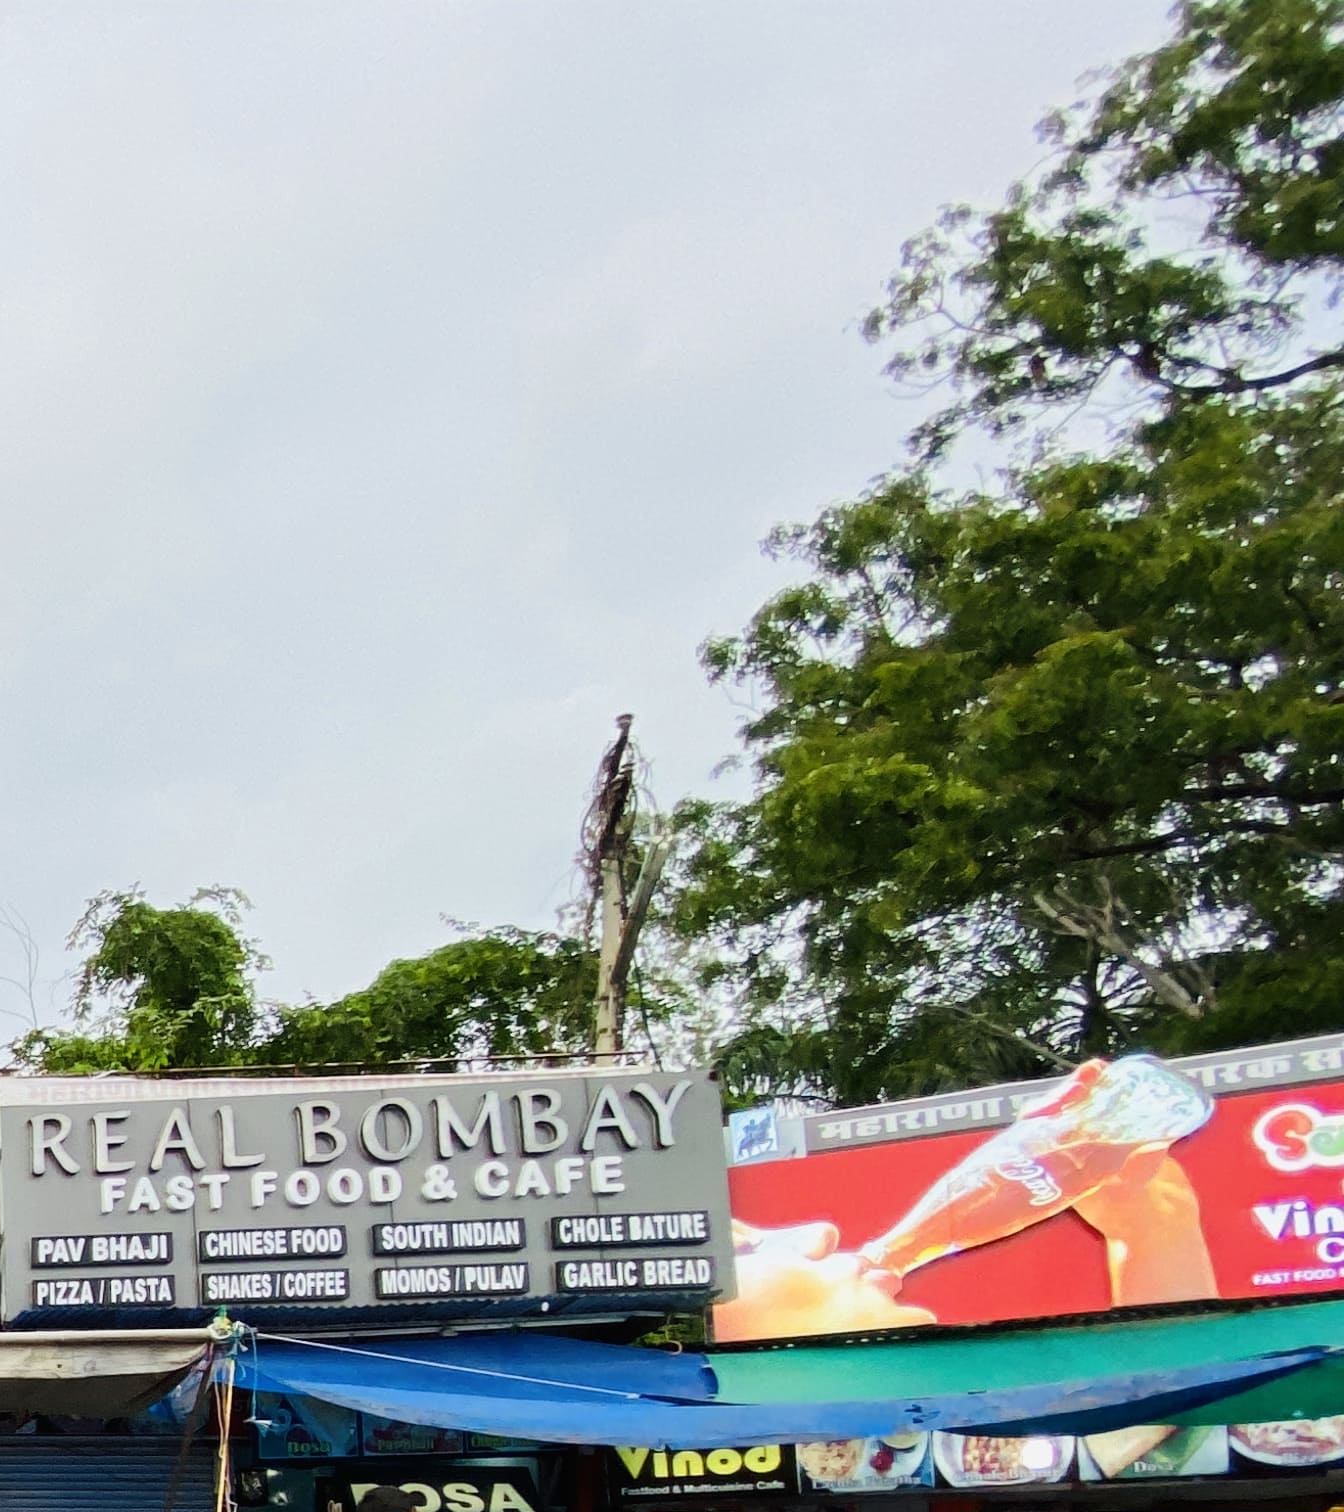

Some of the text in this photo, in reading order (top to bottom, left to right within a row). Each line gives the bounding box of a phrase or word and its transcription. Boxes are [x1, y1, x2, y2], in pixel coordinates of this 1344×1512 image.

[26, 1078, 694, 1177] REAL BOMBAY
[99, 1155, 627, 1215] FAST FOOD & CAFE
[204, 1227, 344, 1258] CHINESE FOOD
[381, 1219, 521, 1251] SOUTH INDIAN
[558, 1212, 707, 1245] CHOLE BATURE
[36, 1234, 169, 1264] PAV BHAJI
[206, 1274, 273, 1300] SHAKES
[283, 1270, 347, 1298] COFFEE
[380, 1267, 452, 1294] MOMOS
[464, 1264, 526, 1292] PULAV
[562, 1257, 712, 1289] GARLIC BREAD
[1253, 1271, 1290, 1286] FAST
[36, 1280, 94, 1306] PIZZA
[109, 1277, 173, 1303] PASTA
